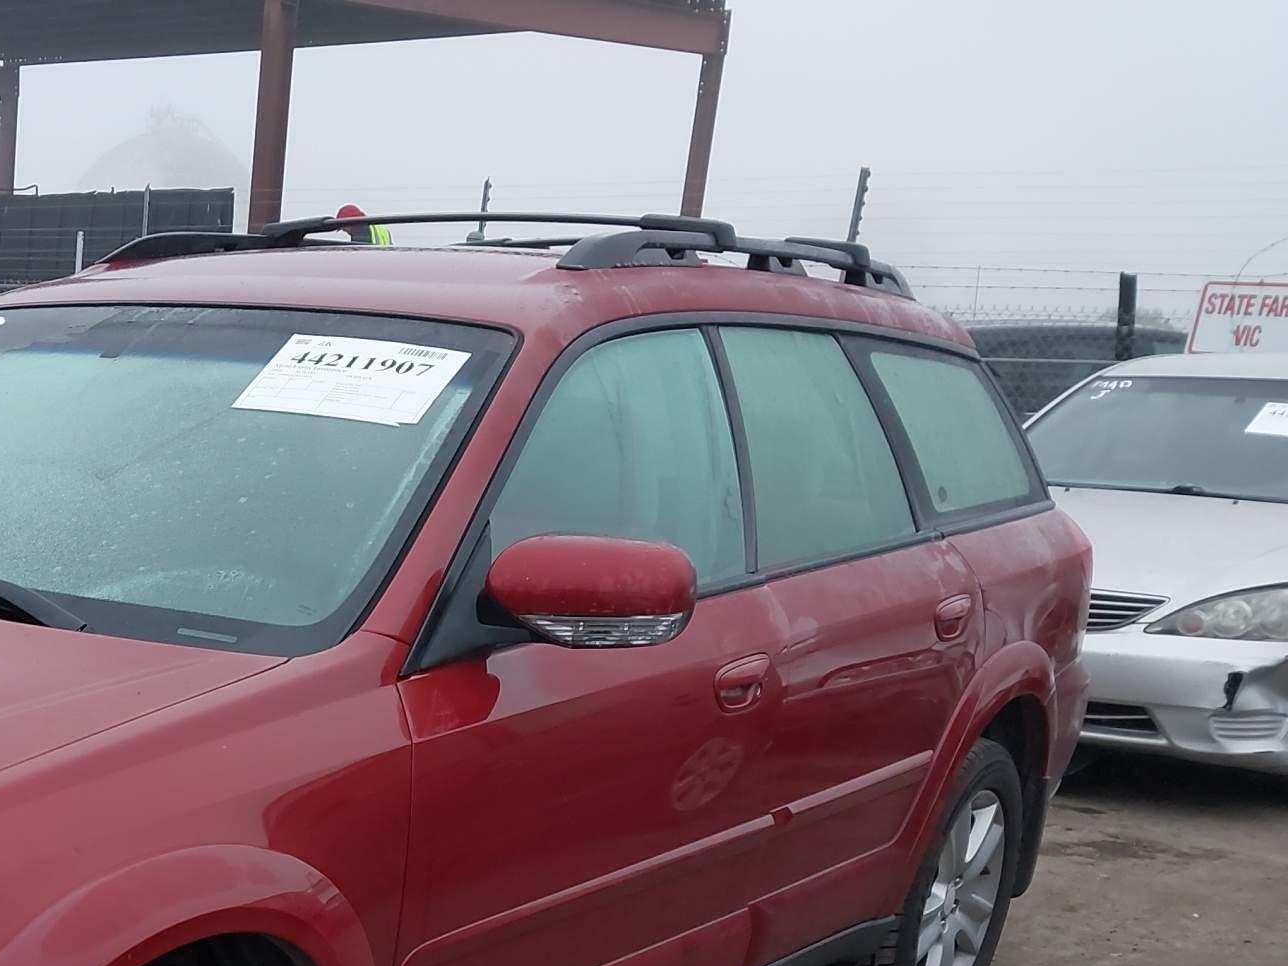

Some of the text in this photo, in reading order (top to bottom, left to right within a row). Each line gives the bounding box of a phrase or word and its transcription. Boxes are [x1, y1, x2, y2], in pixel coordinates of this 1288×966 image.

[1205, 292, 1257, 317] STATE
[1232, 324, 1262, 348] VIC
[290, 350, 435, 378] 44211907
